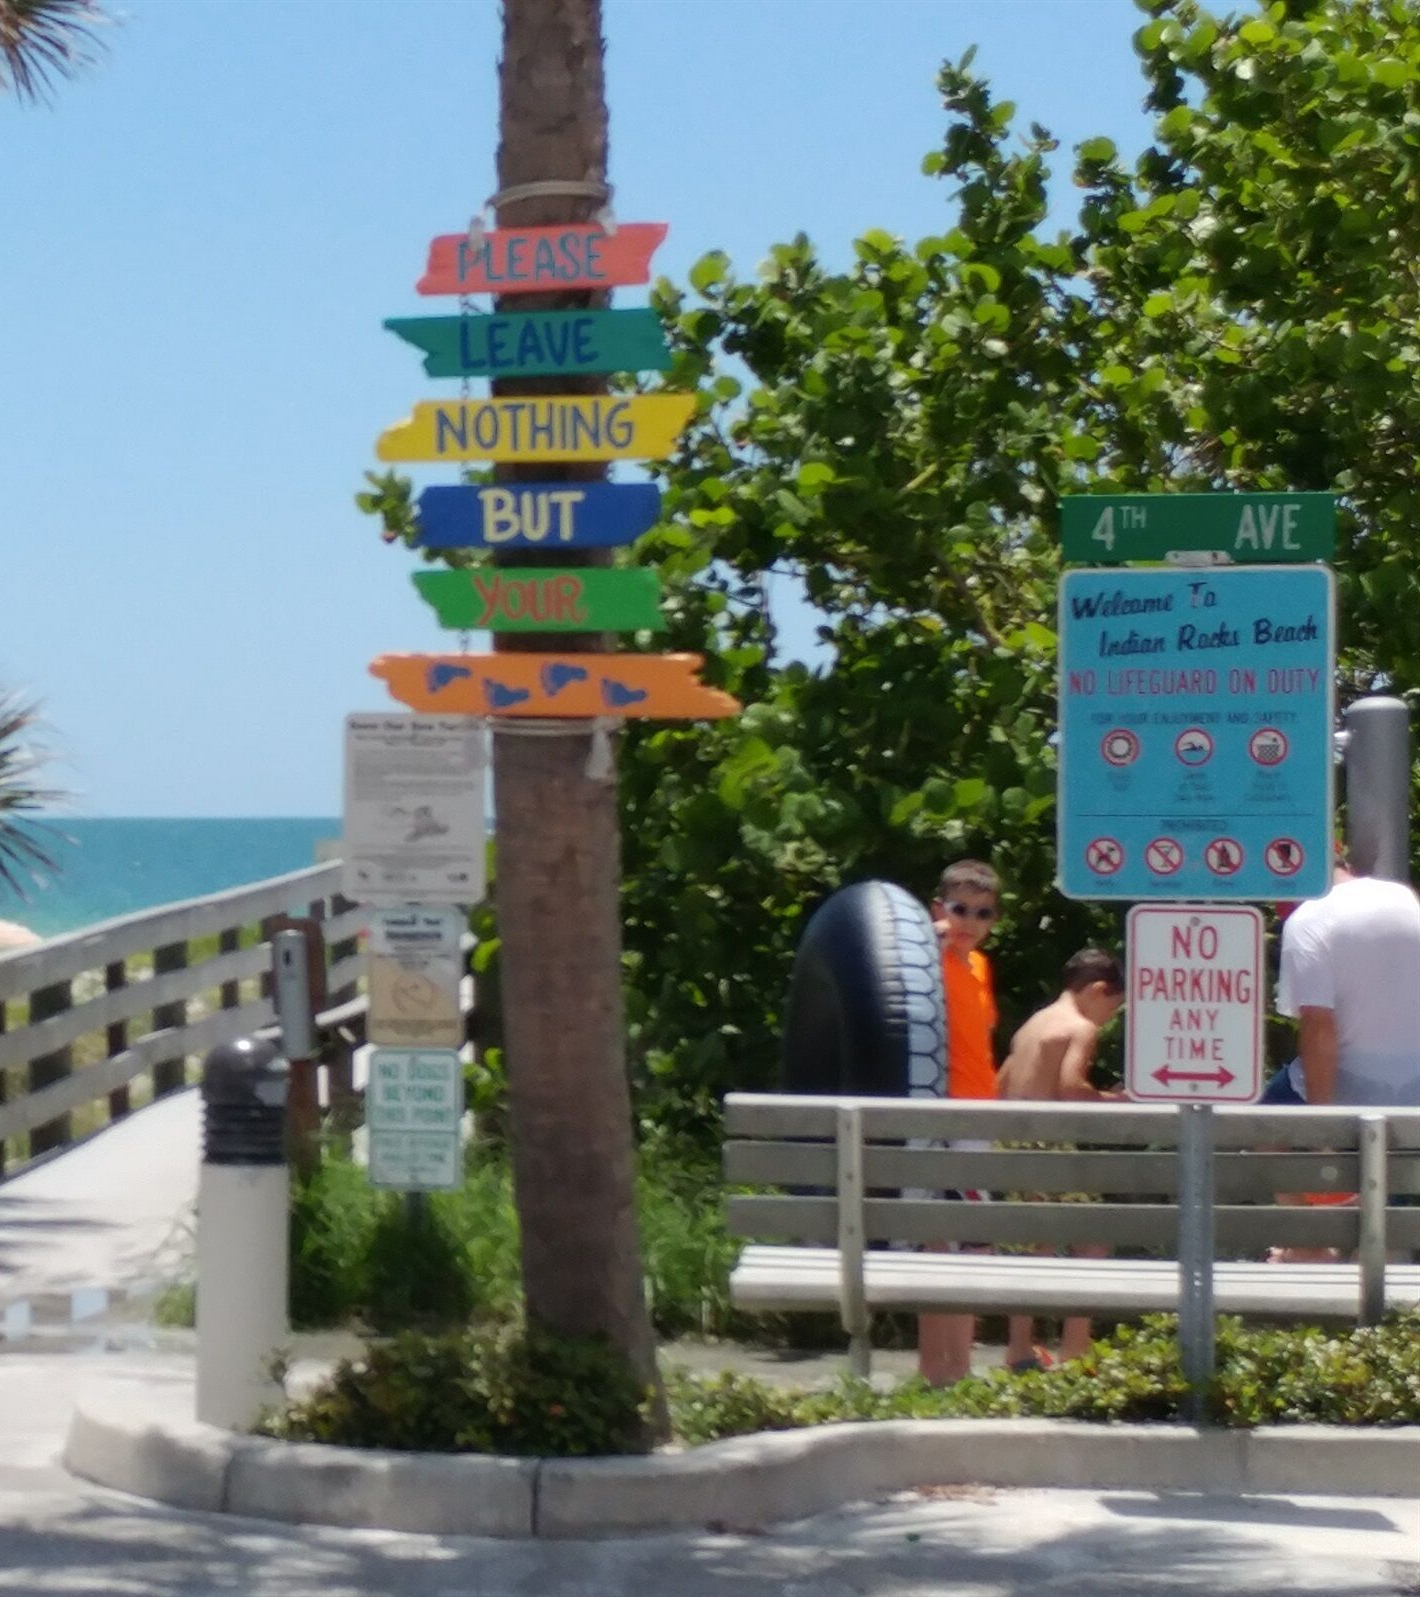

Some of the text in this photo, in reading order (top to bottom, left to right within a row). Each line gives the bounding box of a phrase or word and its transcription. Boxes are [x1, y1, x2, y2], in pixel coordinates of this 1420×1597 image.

[457, 231, 608, 282] PLEASE
[458, 317, 600, 370] LEAVE
[435, 401, 635, 454] NOTHING
[477, 487, 586, 543] BUT
[1091, 503, 1302, 551] 4TH AVE
[472, 573, 590, 627] YOUR
[1071, 580, 1218, 621] Welcome To
[1098, 614, 1319, 657] Indian Rocks Beach
[1068, 668, 1320, 695] NO LIFEGUARD ON DUTY
[1171, 925, 1219, 960] NO
[1138, 967, 1252, 1004] PARKING
[1168, 1006, 1220, 1031] ANY
[1164, 1036, 1225, 1061] TIME
